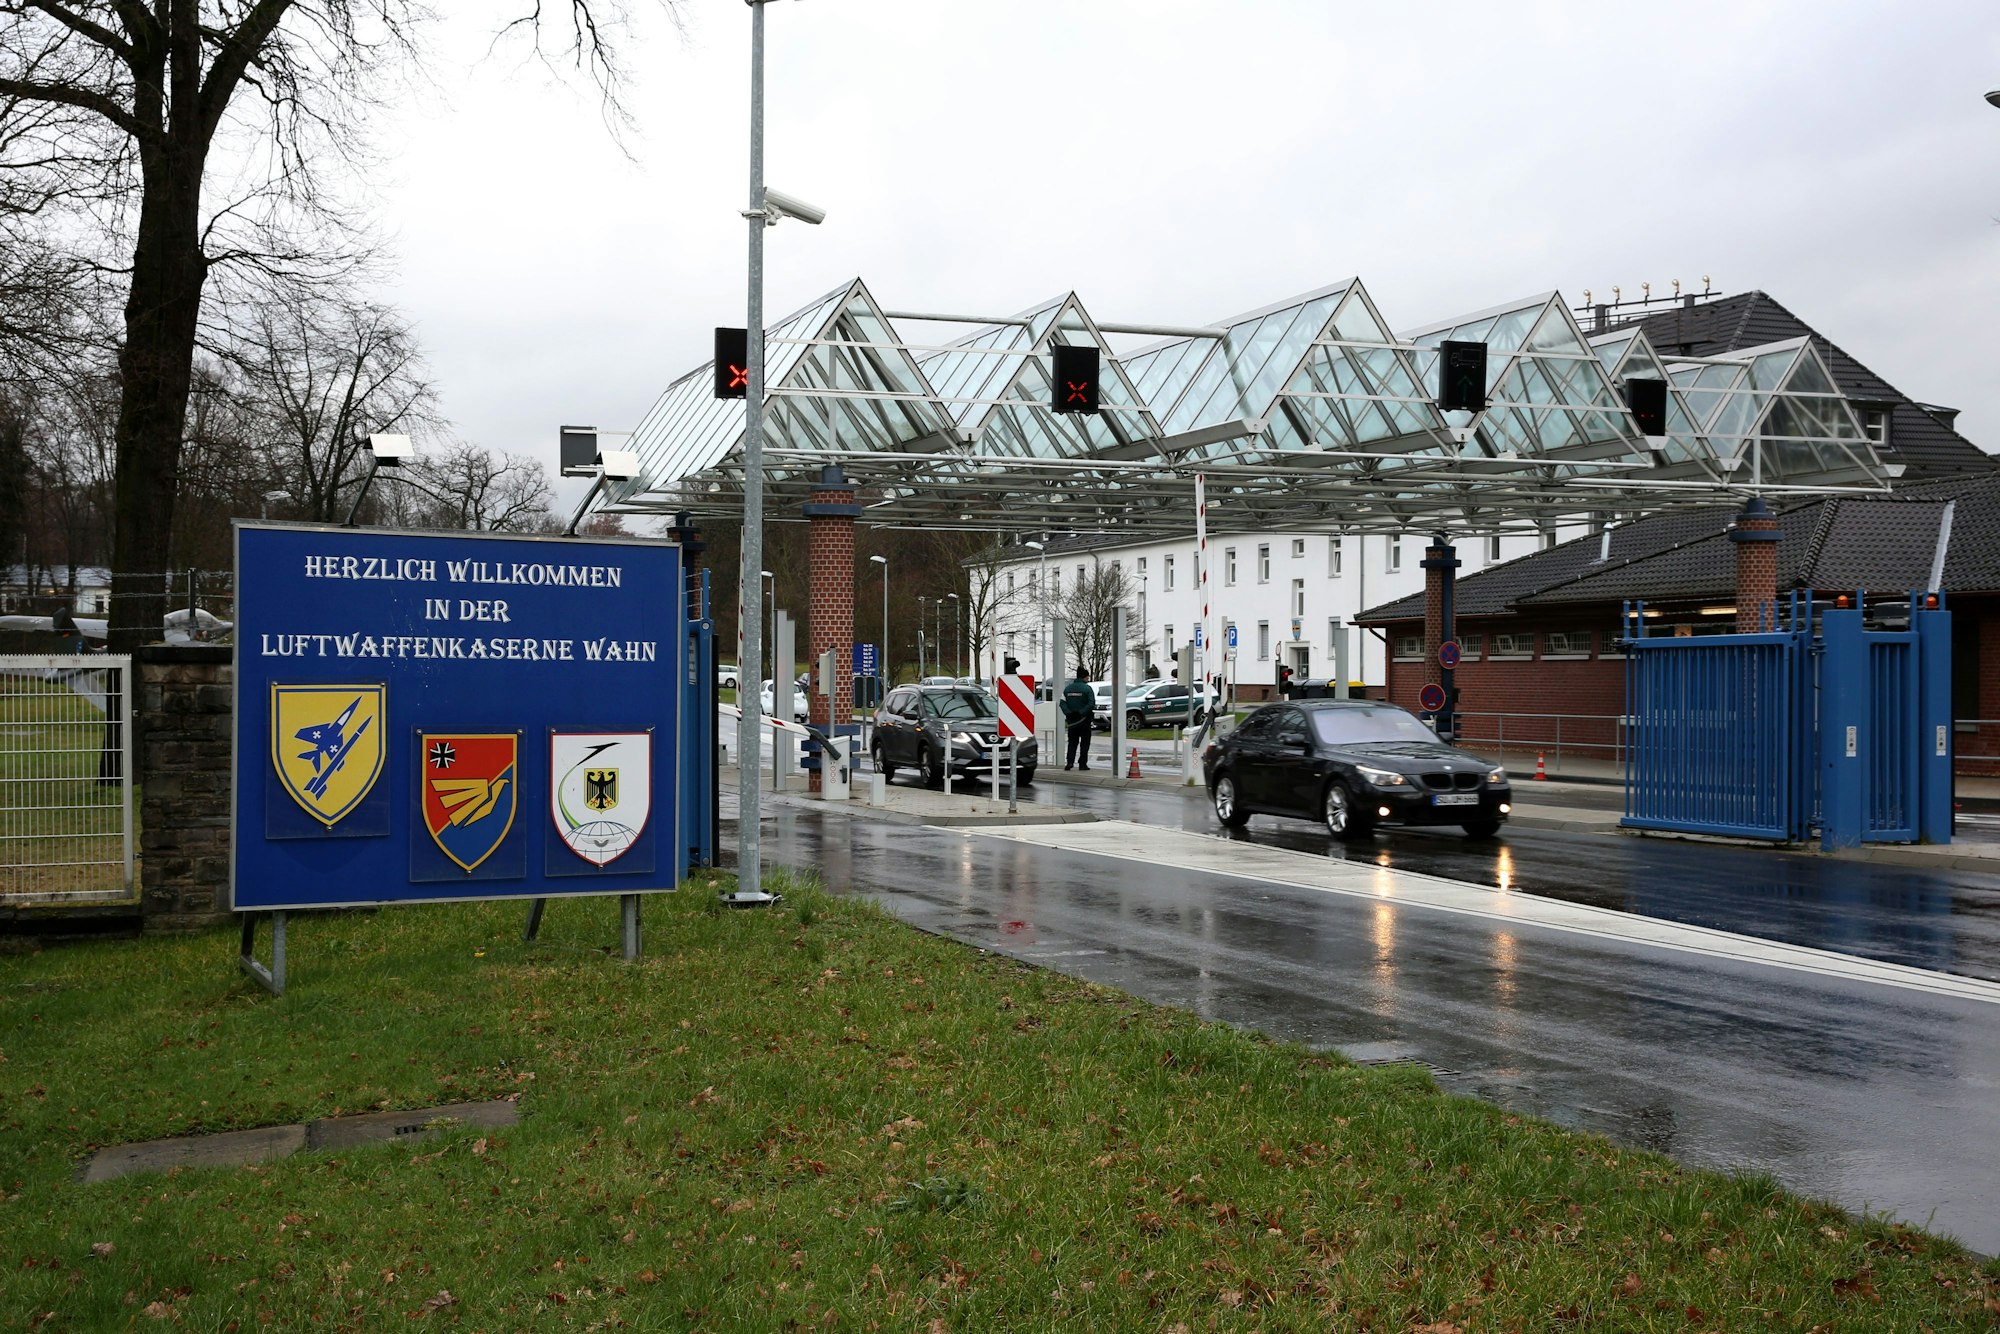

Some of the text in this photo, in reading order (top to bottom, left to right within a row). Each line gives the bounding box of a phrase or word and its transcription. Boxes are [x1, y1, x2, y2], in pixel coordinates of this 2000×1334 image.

[304, 555, 623, 588] HERZLICH WILLKOMMEN
[425, 598, 512, 623] IN DER
[261, 631, 575, 661] LUFTWAFFENKASERNE
[582, 636, 658, 663] WAHN
